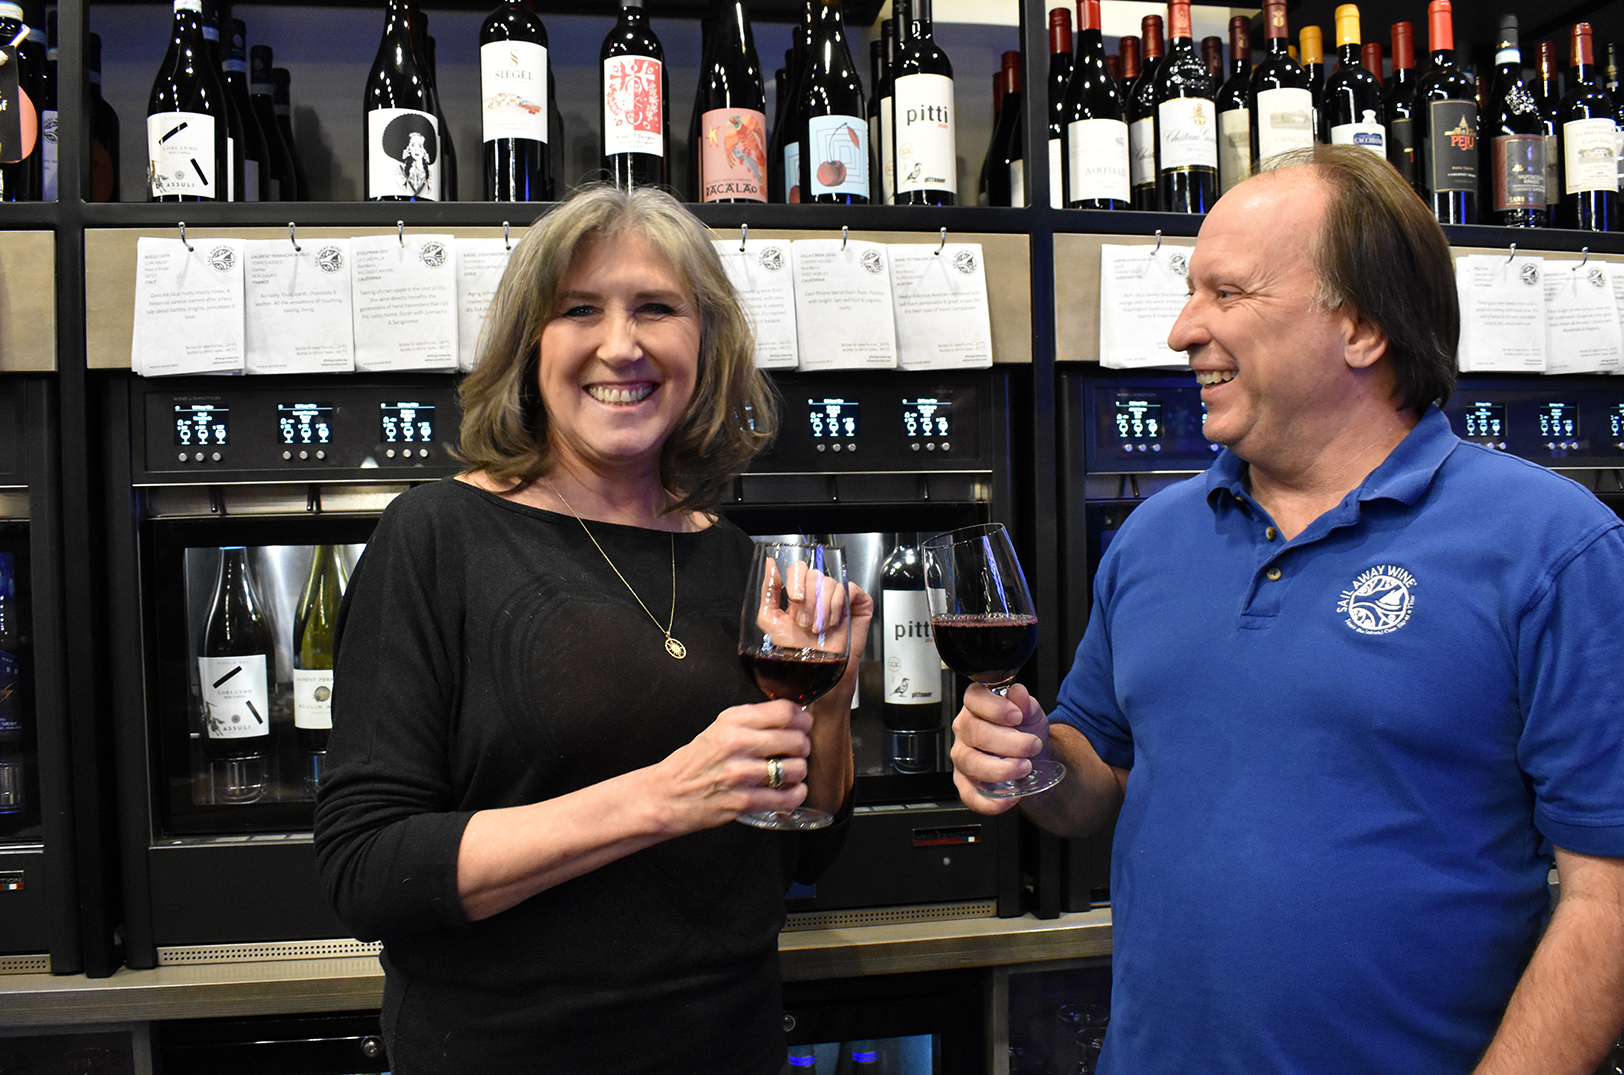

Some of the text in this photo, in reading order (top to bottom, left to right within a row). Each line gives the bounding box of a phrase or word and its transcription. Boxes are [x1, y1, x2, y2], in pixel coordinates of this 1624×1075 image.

[494, 70, 535, 81] SIEGEL
[906, 104, 949, 126] pitti
[1450, 134, 1475, 151] PEJU
[1084, 167, 1128, 177] AIRFIELD
[1336, 564, 1416, 613] SAIL AWAY WINE
[895, 620, 932, 641] pitt
[222, 724, 252, 732] ASSULI
